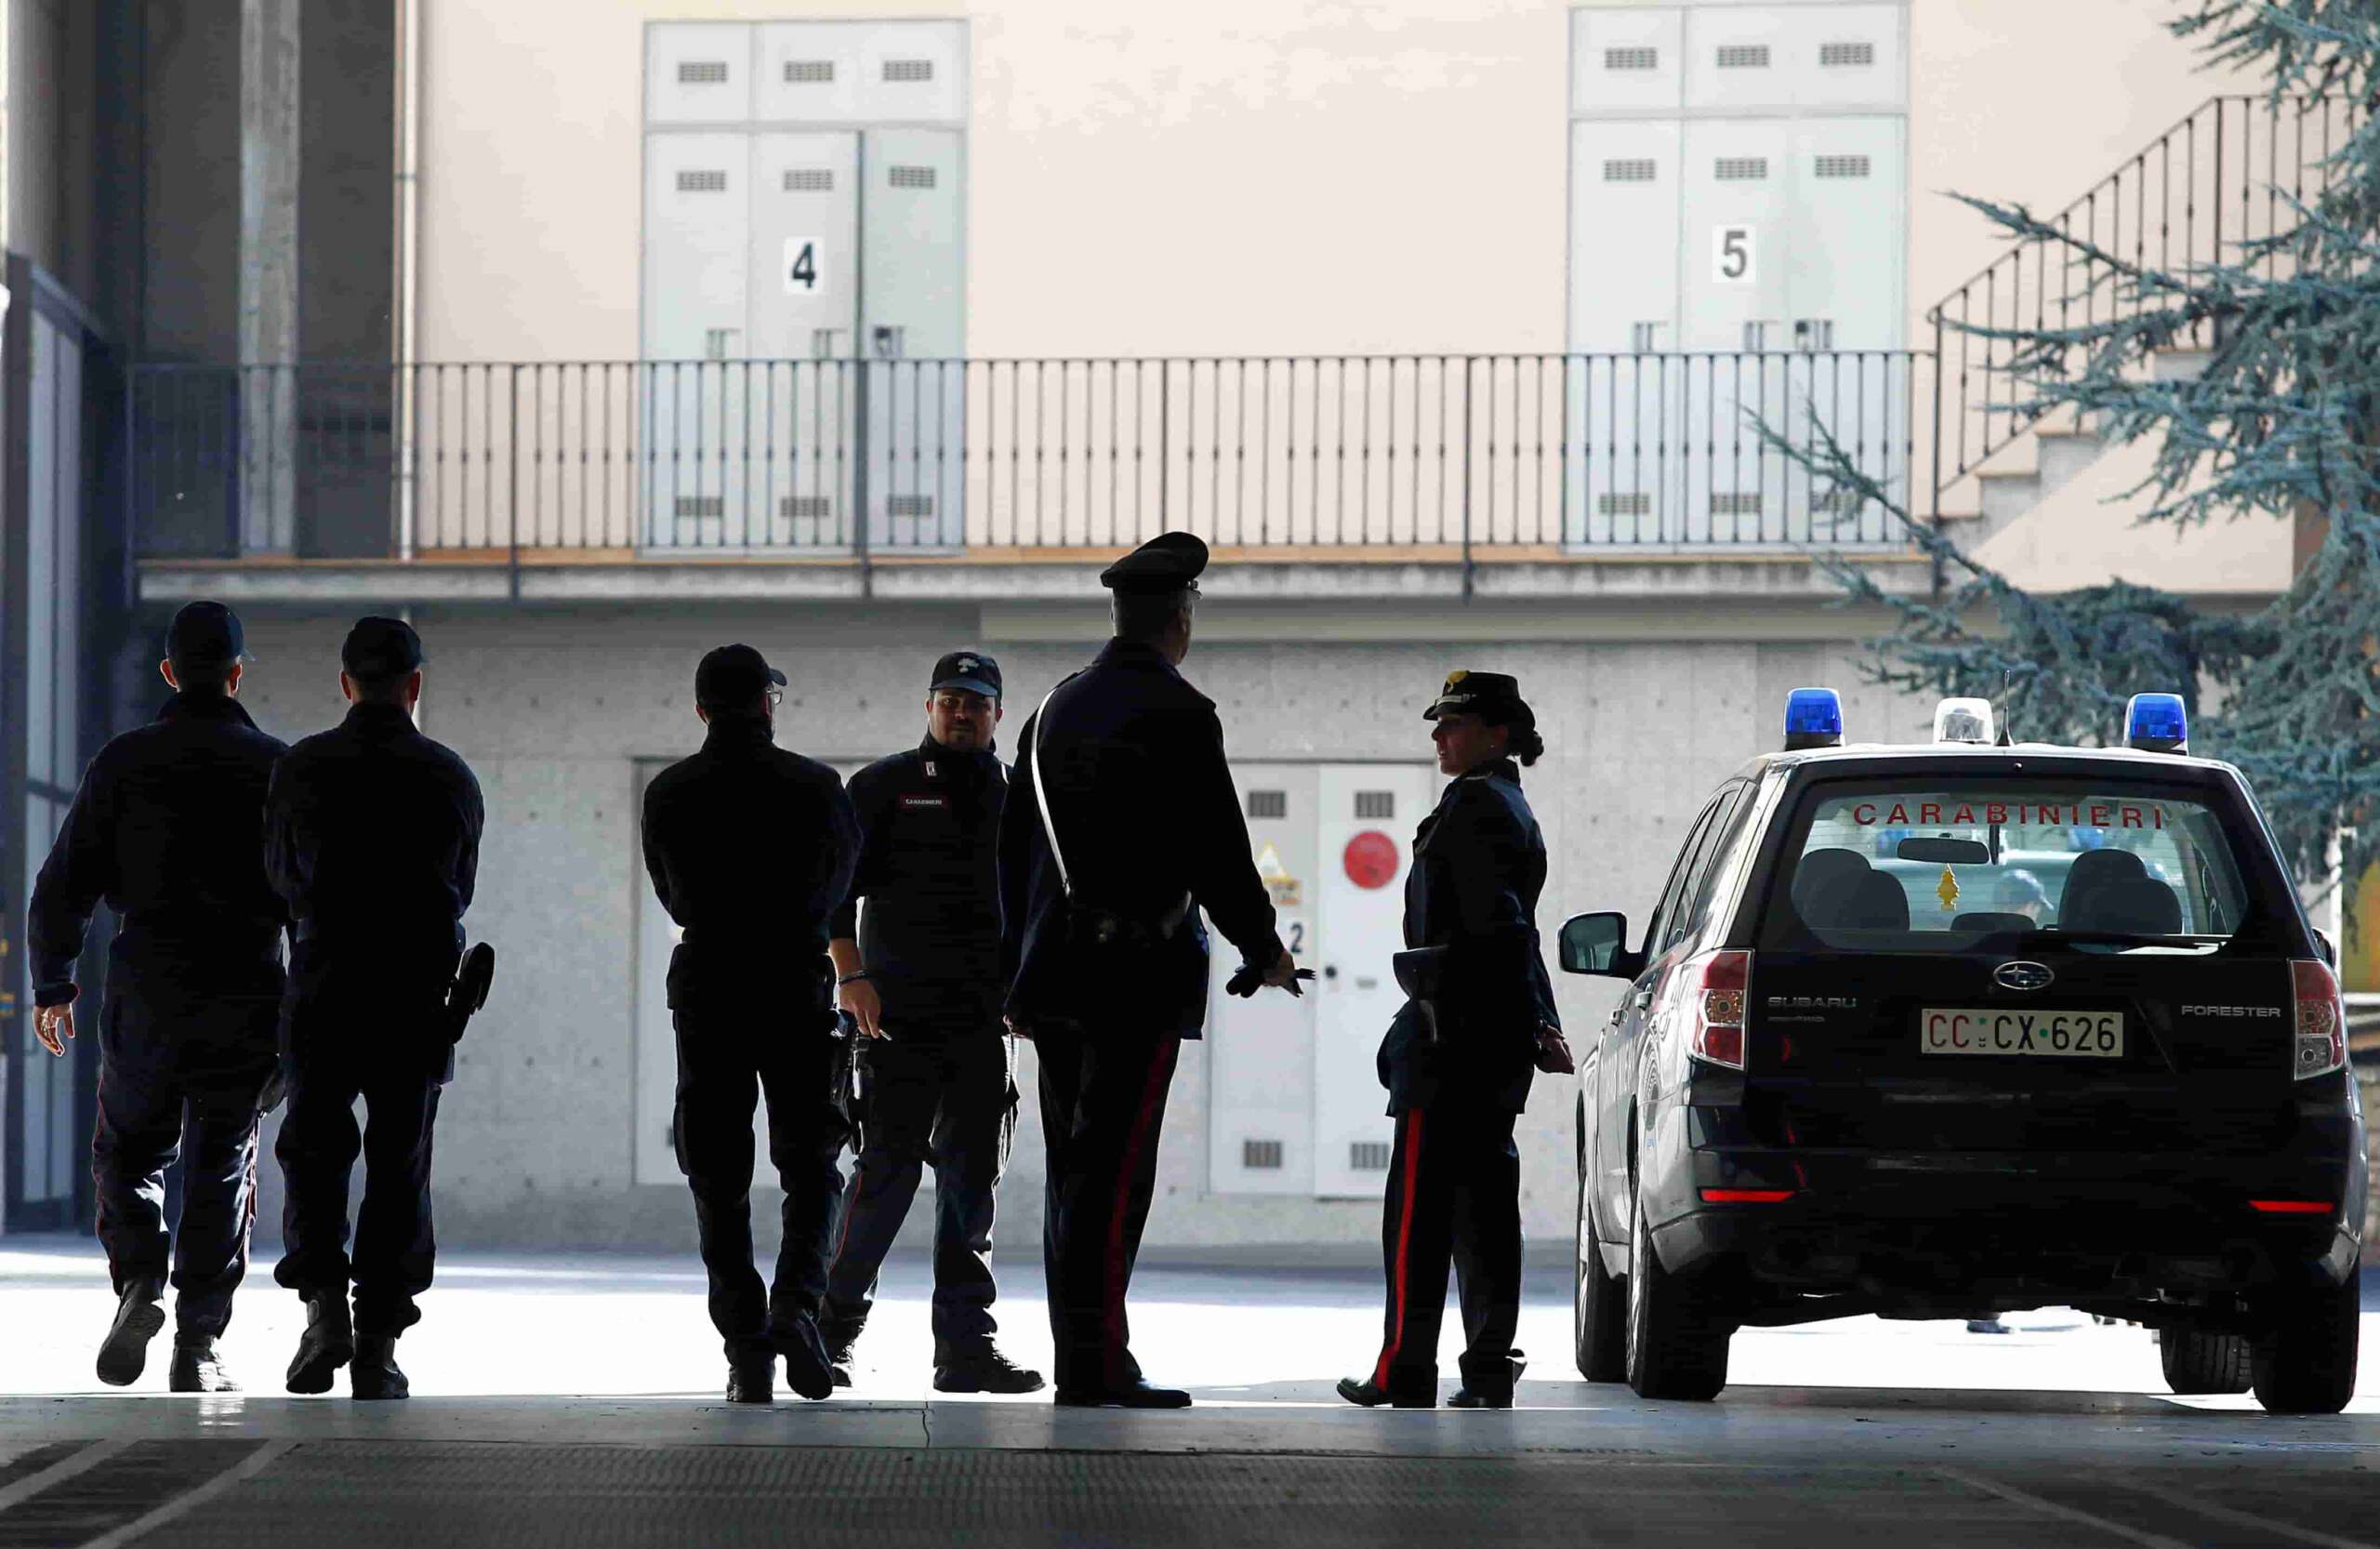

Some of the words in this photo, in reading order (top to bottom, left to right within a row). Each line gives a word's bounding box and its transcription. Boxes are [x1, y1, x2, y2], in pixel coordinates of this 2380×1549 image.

[790, 241, 817, 290] 4
[1721, 229, 1748, 279] 5
[1852, 801, 2162, 830] CARABINIERI
[1289, 923, 1303, 953] 2
[1767, 996, 1858, 1009] SUBARU
[2180, 1004, 2281, 1018] FORESTER
[1928, 1013, 1970, 1049] CC
[1993, 1014, 2035, 1050] CX
[2051, 1015, 2117, 1053] 626
